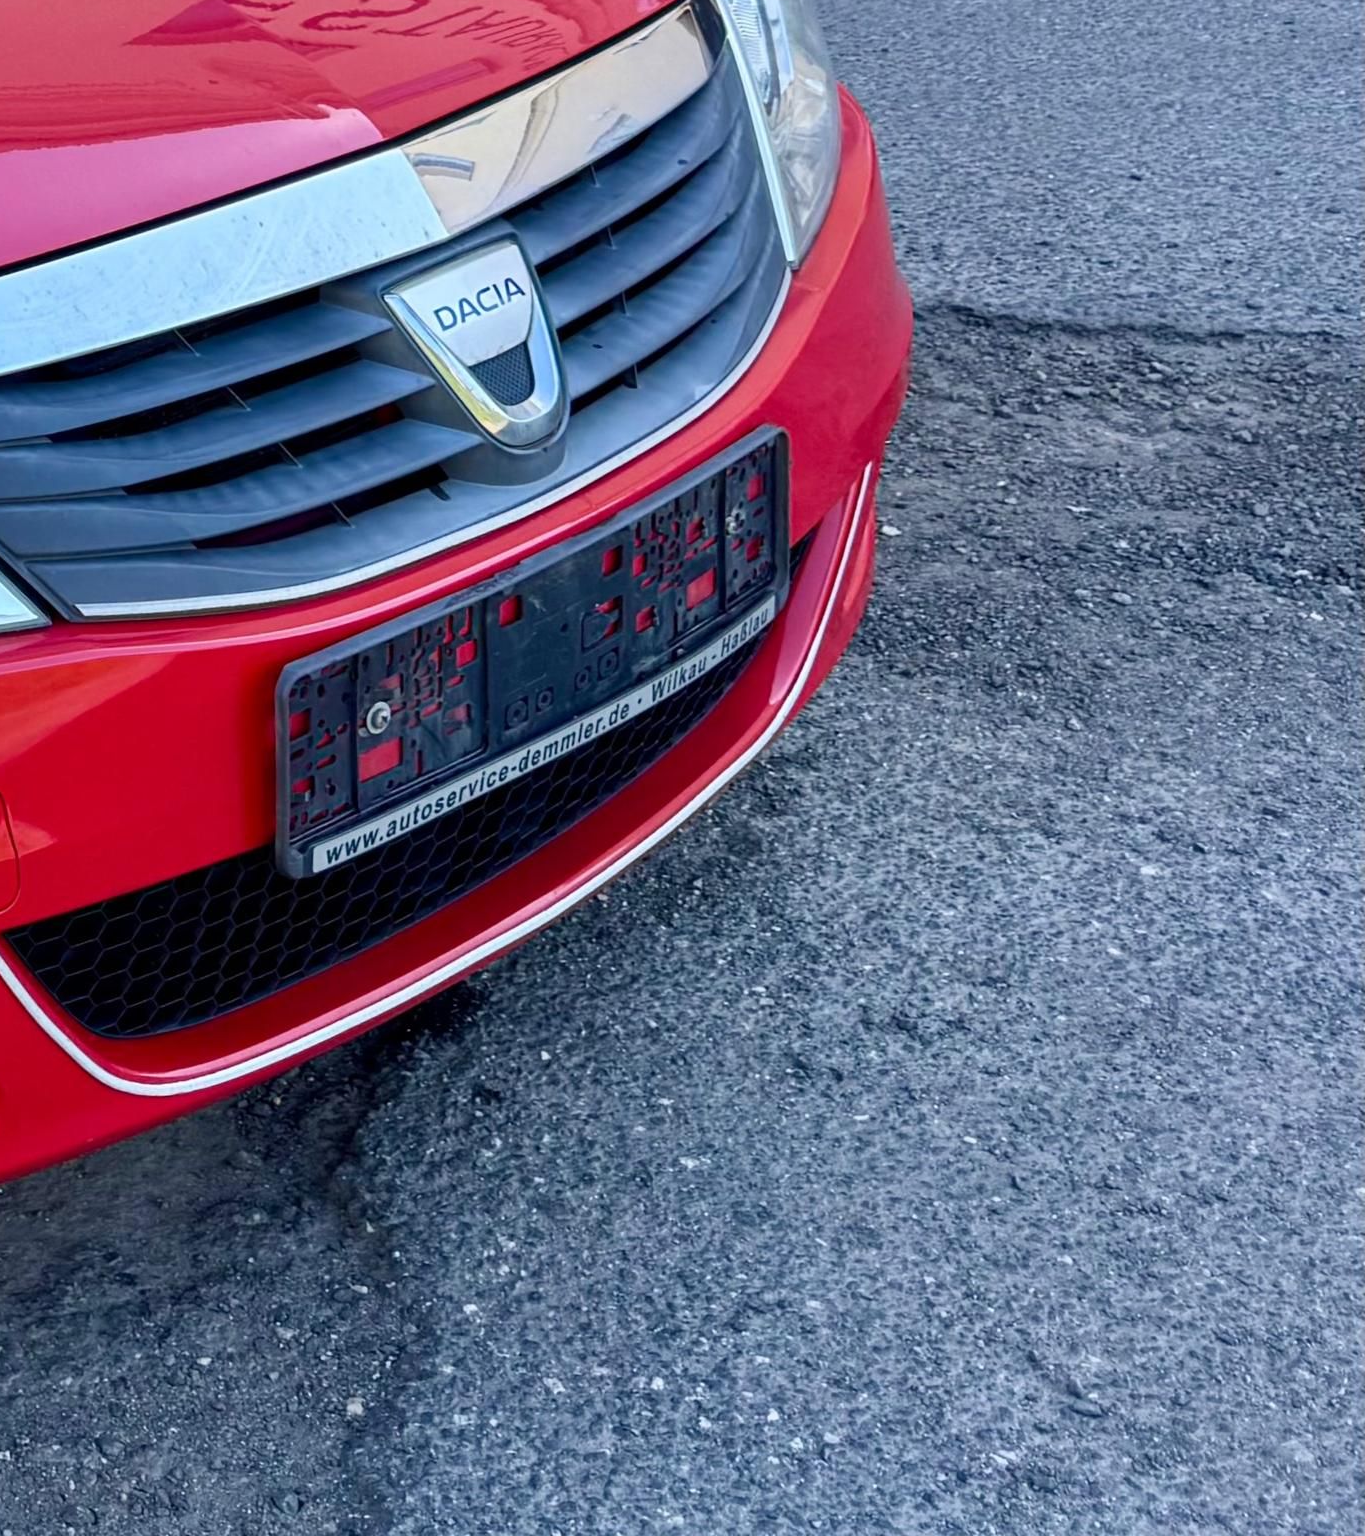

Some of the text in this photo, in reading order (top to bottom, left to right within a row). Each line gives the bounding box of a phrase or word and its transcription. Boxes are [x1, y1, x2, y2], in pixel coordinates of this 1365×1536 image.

[433, 277, 526, 331] DACIA
[326, 699, 630, 865] www.autoservice-demmler.de
[651, 658, 709, 702] Wilkau
[720, 608, 768, 658] Haßlau
